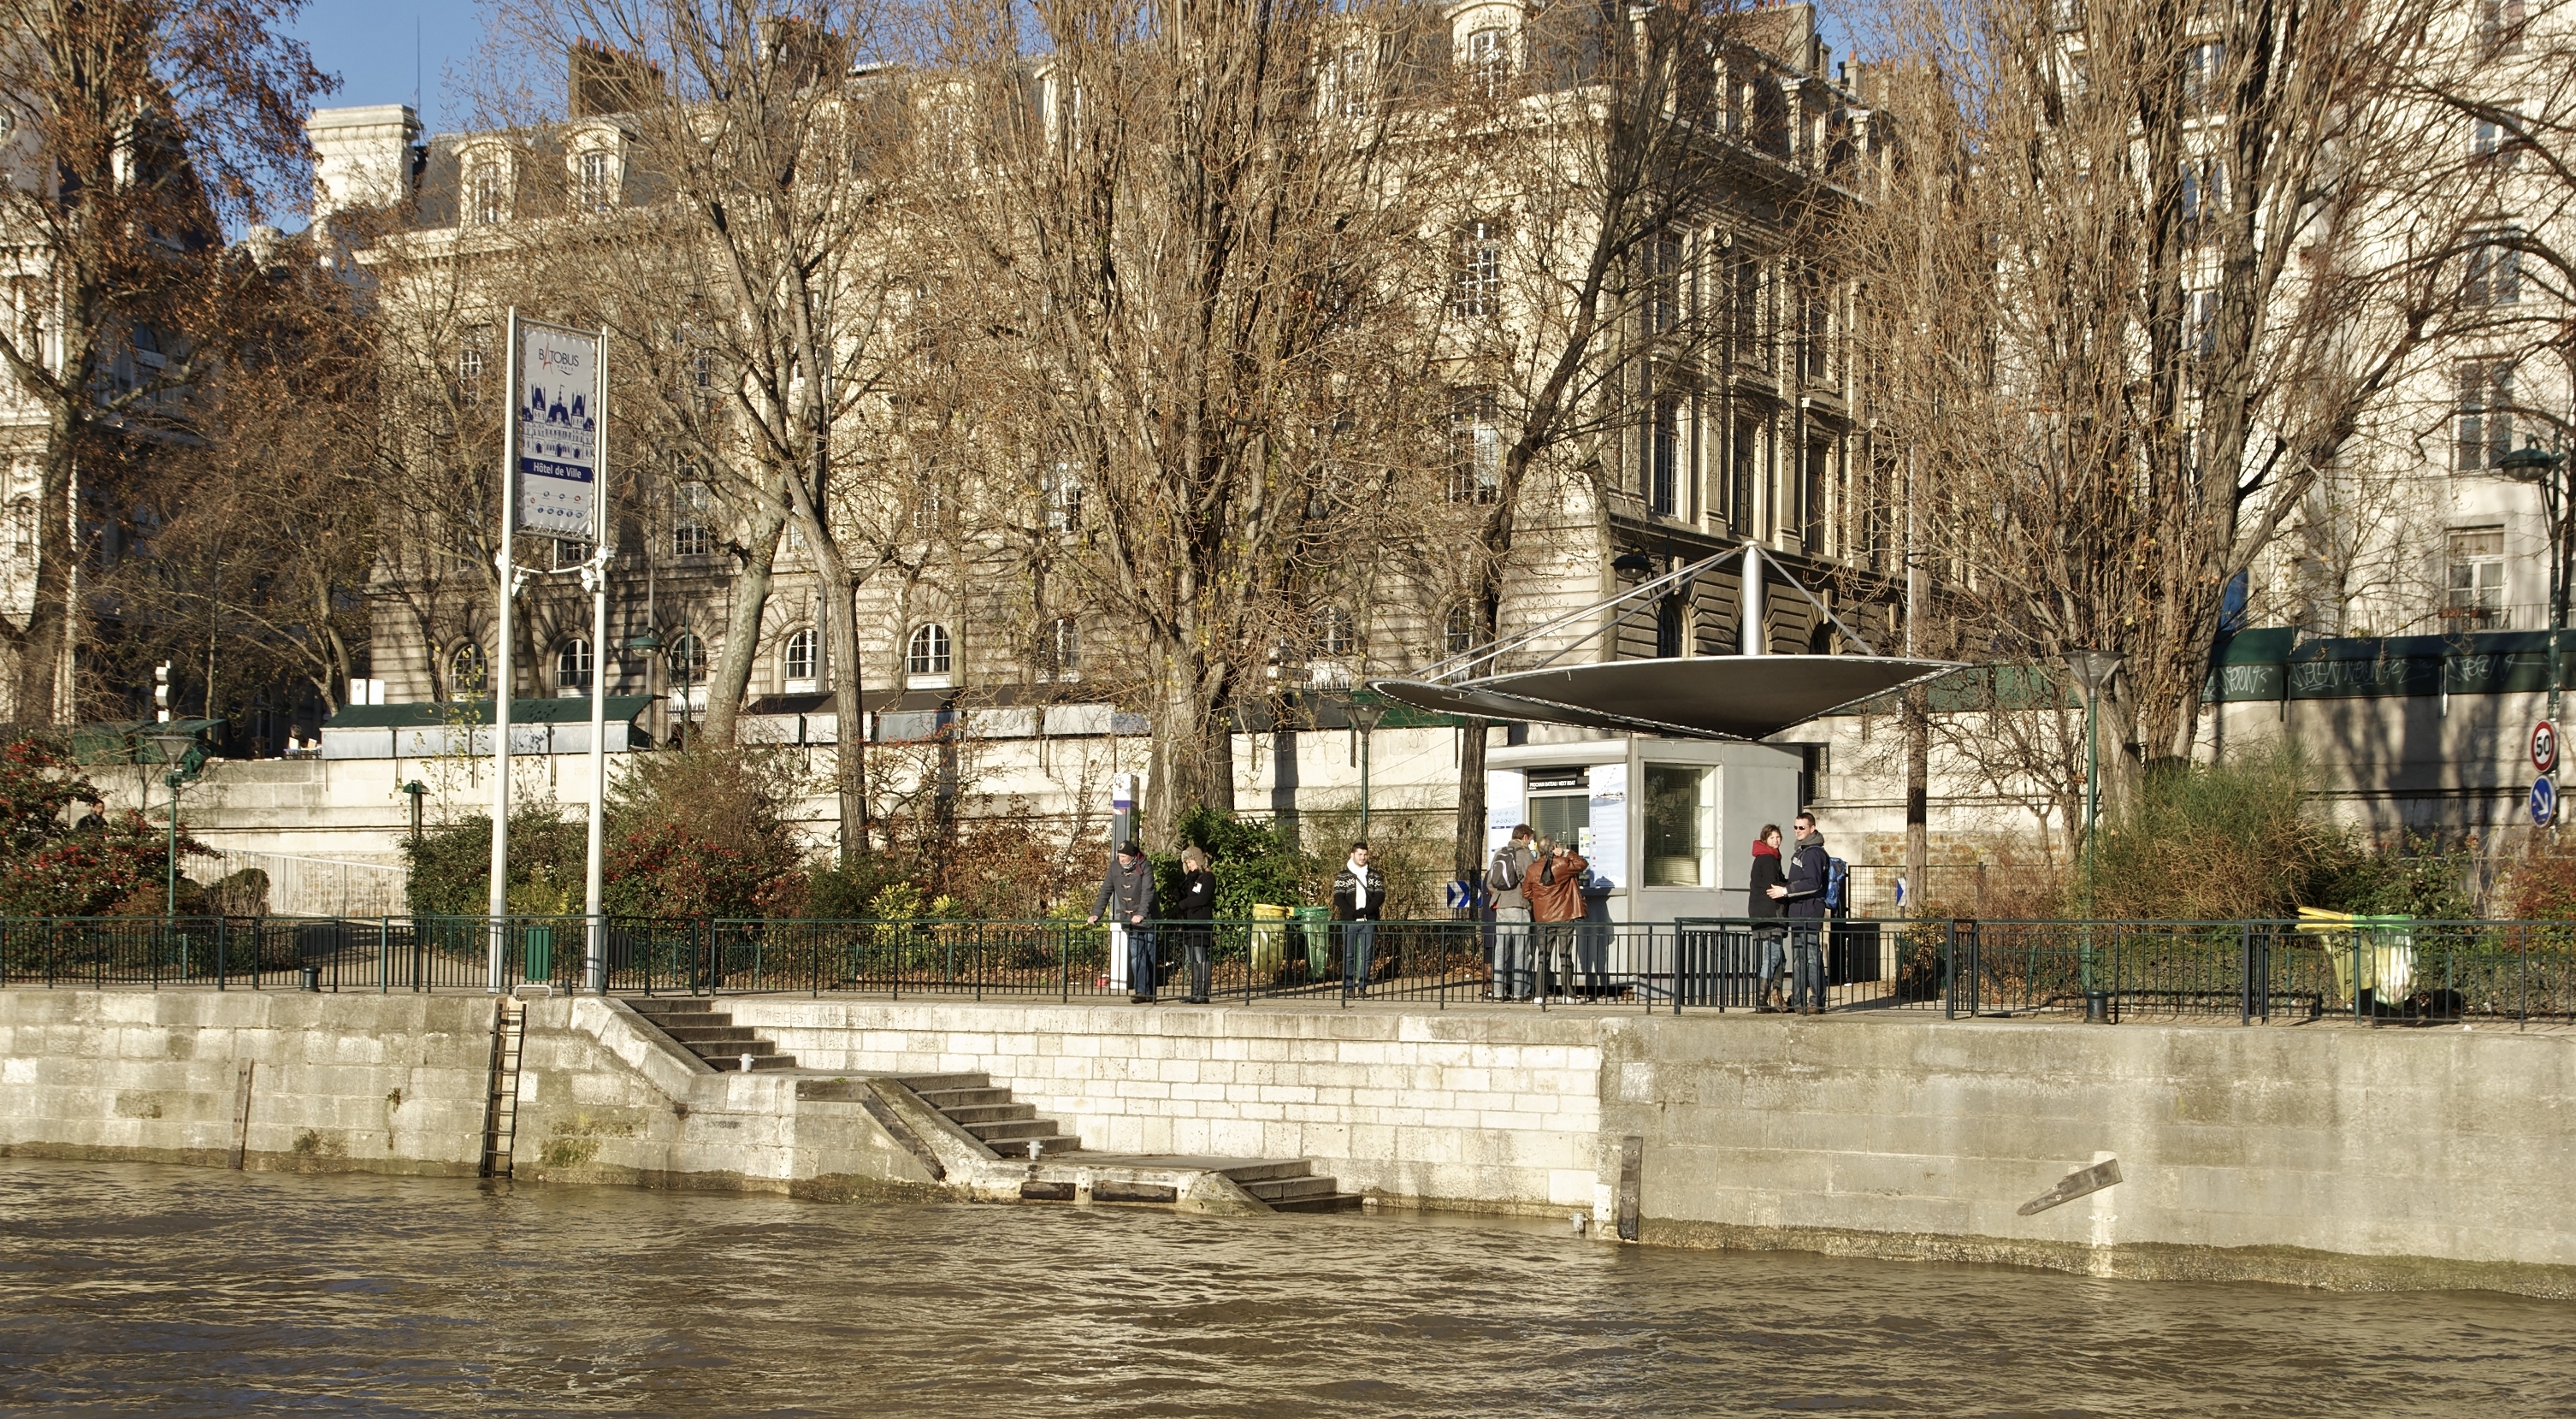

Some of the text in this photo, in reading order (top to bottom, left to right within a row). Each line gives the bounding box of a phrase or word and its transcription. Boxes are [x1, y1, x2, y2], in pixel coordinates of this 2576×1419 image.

[539, 340, 579, 375] BATOBUS
[533, 462, 582, 479] Hôtel de Ville
[2536, 735, 2550, 757] 50
